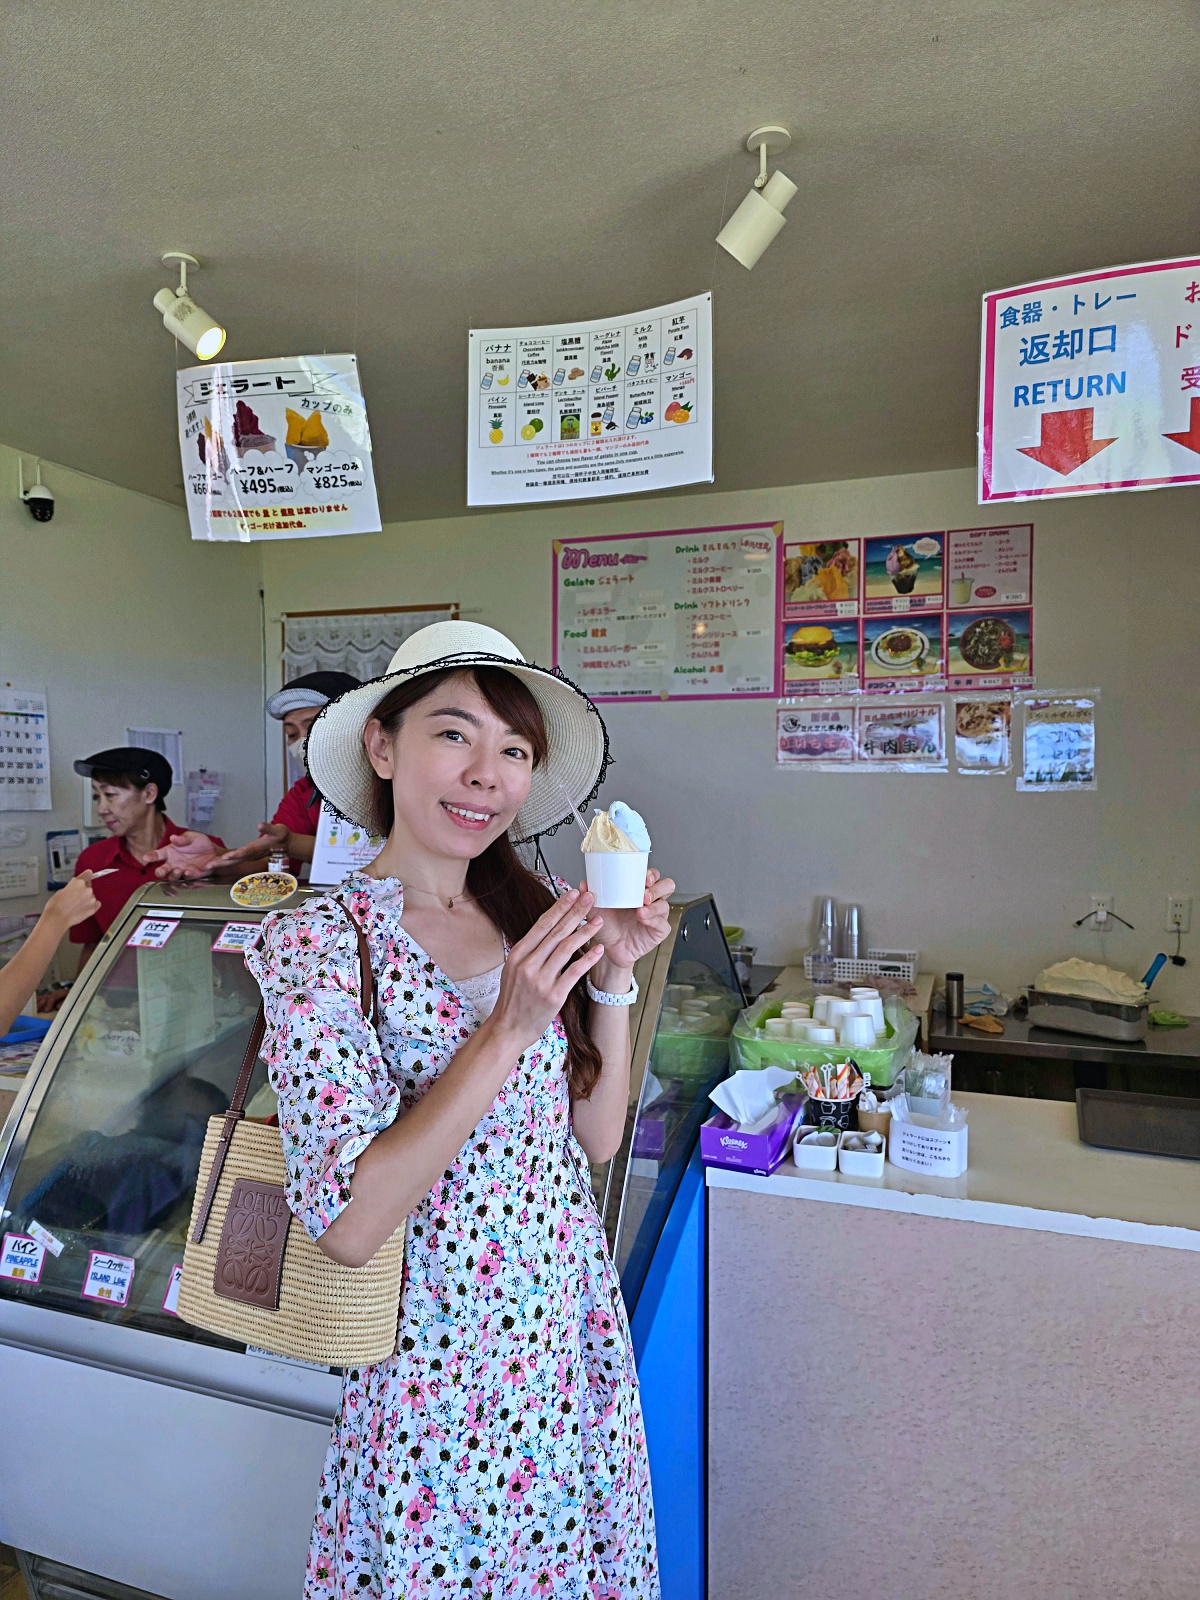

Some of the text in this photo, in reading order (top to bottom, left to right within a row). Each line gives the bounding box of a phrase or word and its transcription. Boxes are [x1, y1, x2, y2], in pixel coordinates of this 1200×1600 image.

[1000, 293, 1137, 329] 食器・トレー
[634, 325, 652, 335] ミルク
[485, 343, 512, 353] バナナ
[1019, 324, 1117, 367] 返却口
[665, 372, 692, 382] マンゴー
[1013, 371, 1127, 407] RETURN
[301, 398, 354, 415] カップのみ
[306, 462, 360, 474] マンゴーのみ
[675, 545, 700, 553] Drink
[561, 546, 620, 570] Menu
[563, 578, 596, 587] Gelato
[673, 601, 699, 610] Drink
[563, 629, 588, 639] Food
[673, 665, 706, 674] Alcohol
[801, 723, 849, 733] ミルミル手作り
[864, 738, 937, 755] 牛肉まん
[144, 922, 170, 931] バナナ
[719, 1136, 749, 1150] Kleenex
[235, 1189, 287, 1218] LOEWE
[11, 1239, 38, 1254] パイン
[5, 1254, 39, 1267] PINEAPPLE
[90, 1272, 127, 1288] ISLAND LIME
